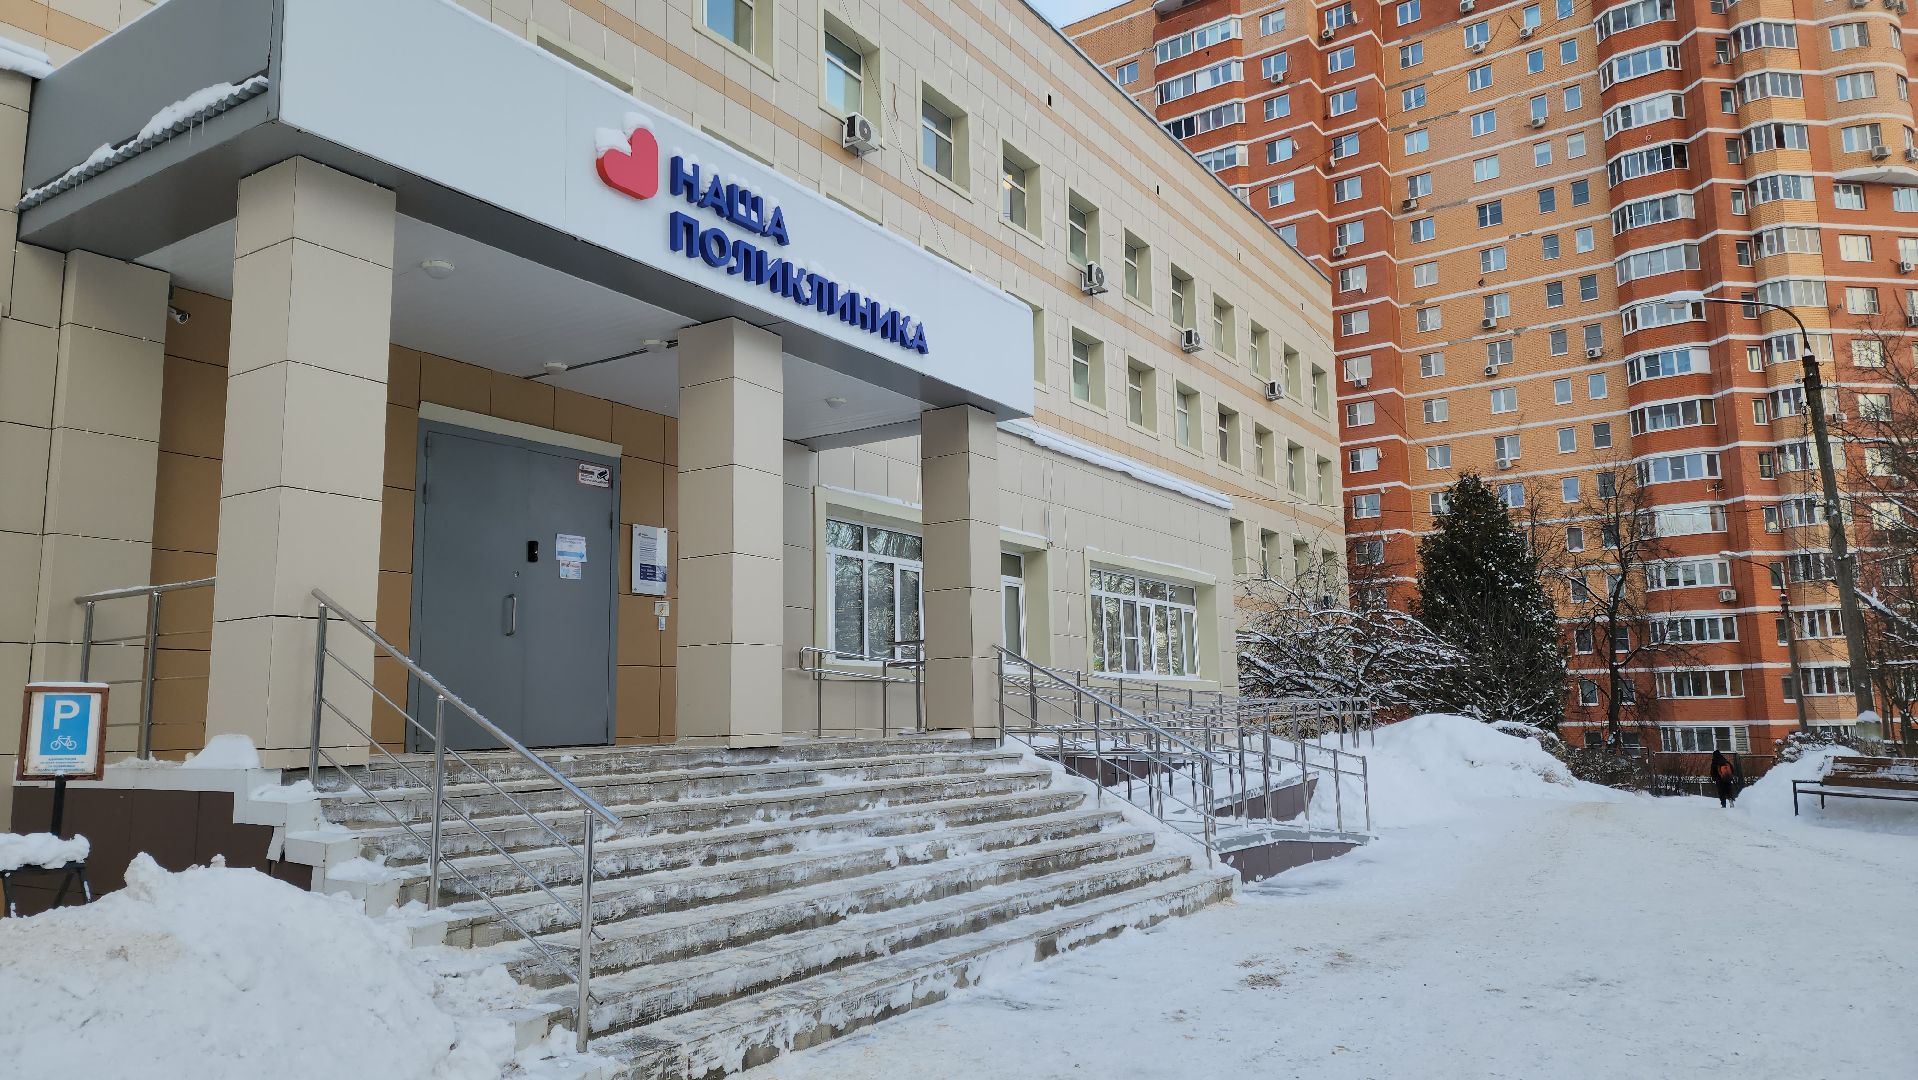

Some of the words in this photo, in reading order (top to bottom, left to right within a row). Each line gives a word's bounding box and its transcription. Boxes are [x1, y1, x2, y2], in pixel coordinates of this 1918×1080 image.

[670, 154, 790, 246] НАША
[669, 210, 929, 355] ПОЛИКЛИНИКА
[53, 700, 80, 730] P
